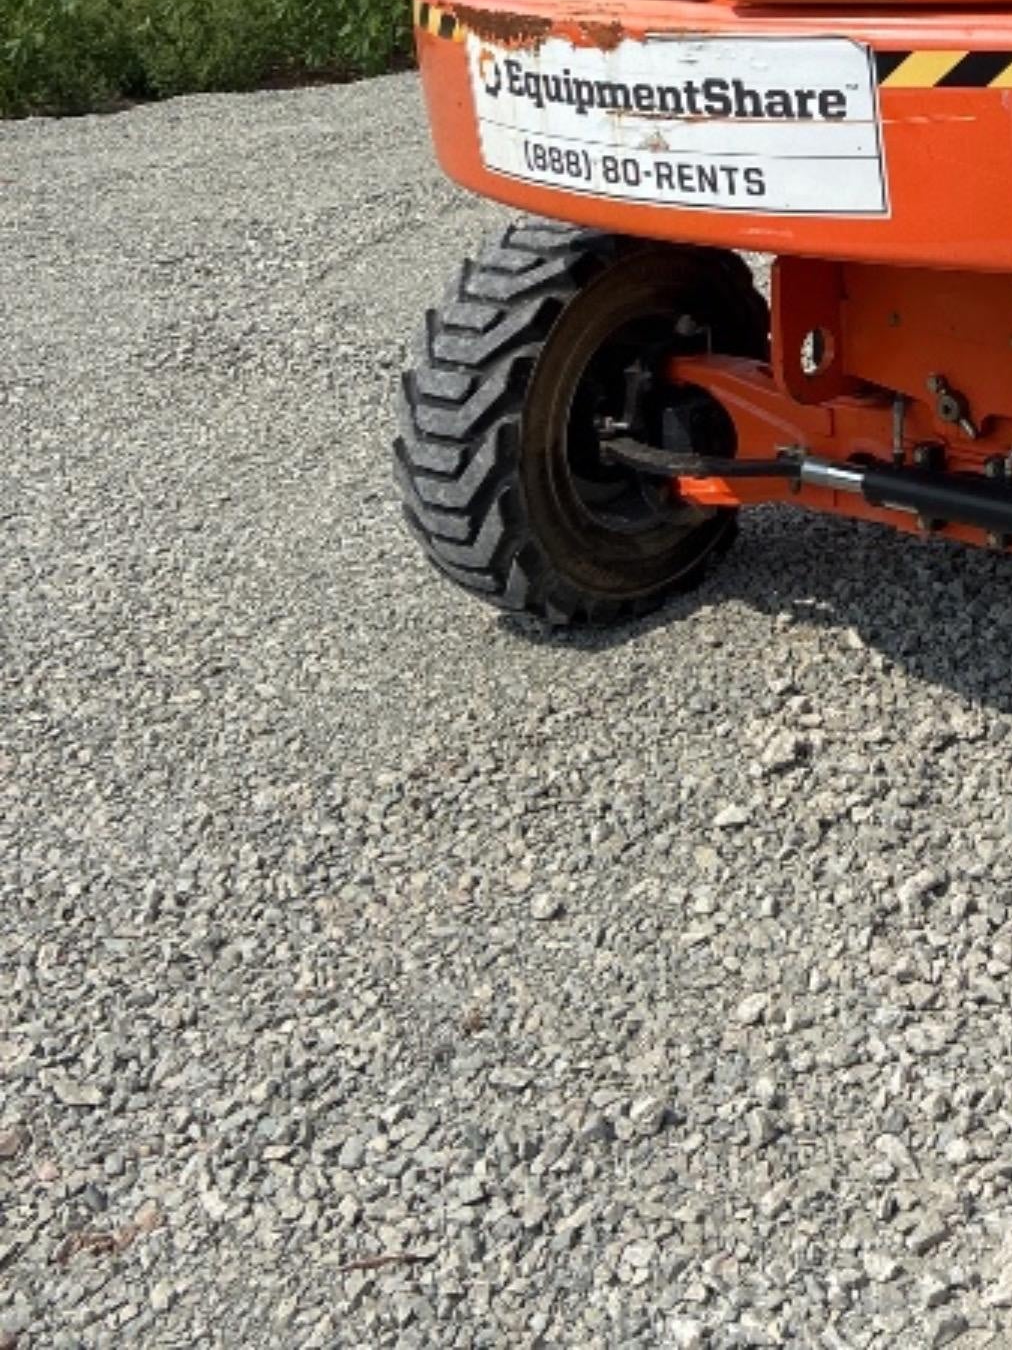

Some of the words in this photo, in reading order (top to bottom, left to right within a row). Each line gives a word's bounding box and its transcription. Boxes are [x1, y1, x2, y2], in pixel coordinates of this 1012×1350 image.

[504, 59, 847, 119] EquipmentShare
[524, 140, 592, 182] (888)
[602, 155, 767, 196] 80-RENTS
